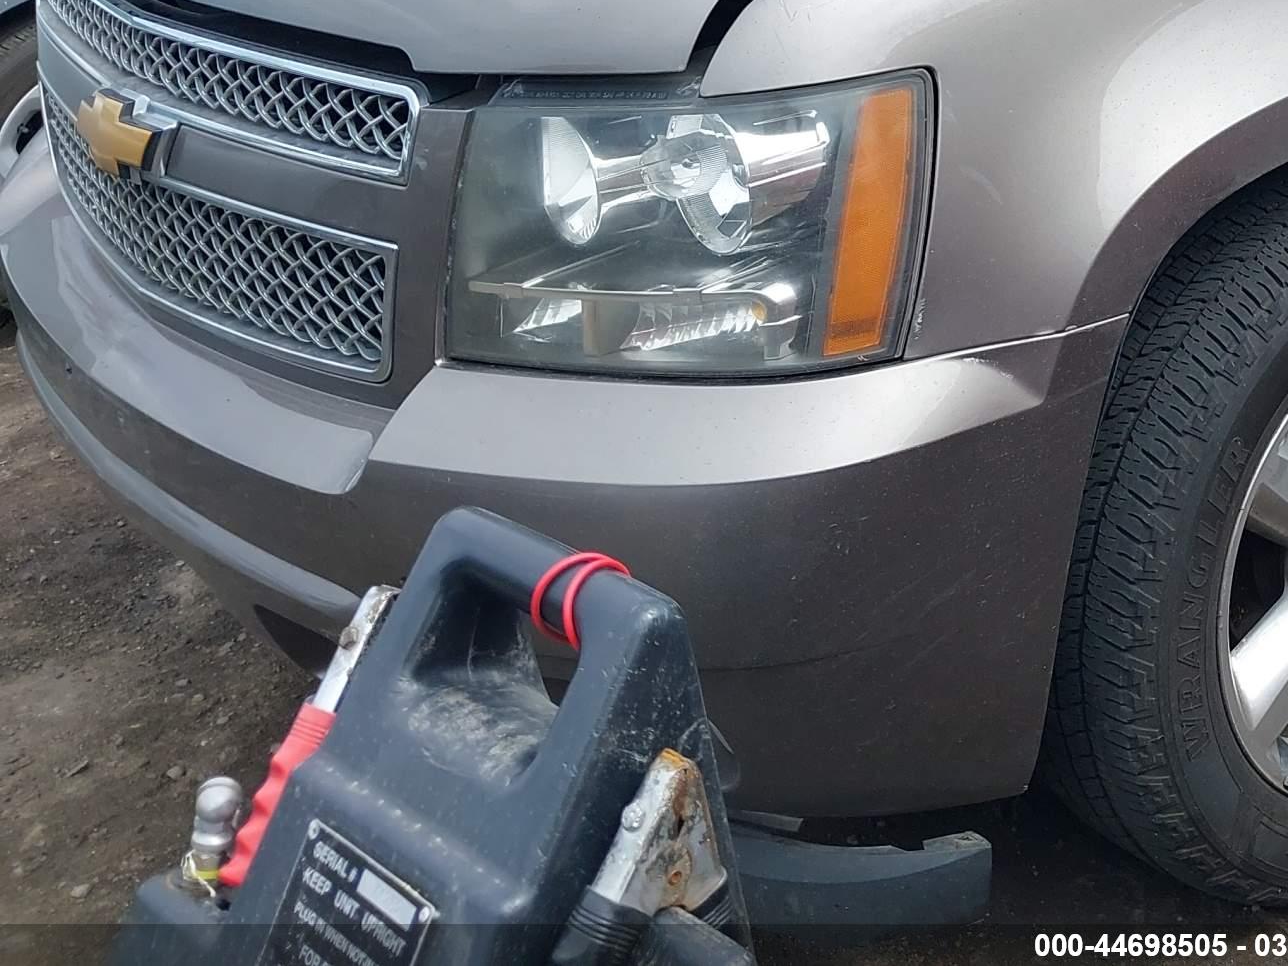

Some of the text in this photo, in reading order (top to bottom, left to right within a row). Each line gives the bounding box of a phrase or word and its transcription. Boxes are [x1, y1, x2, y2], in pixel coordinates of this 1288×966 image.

[1177, 435, 1250, 762] WRANGLER
[313, 841, 348, 878] SERIAL
[294, 901, 316, 926] PLUG
[324, 923, 348, 953] WHEN
[302, 866, 407, 958] KEEP UNIT UPRIGHT
